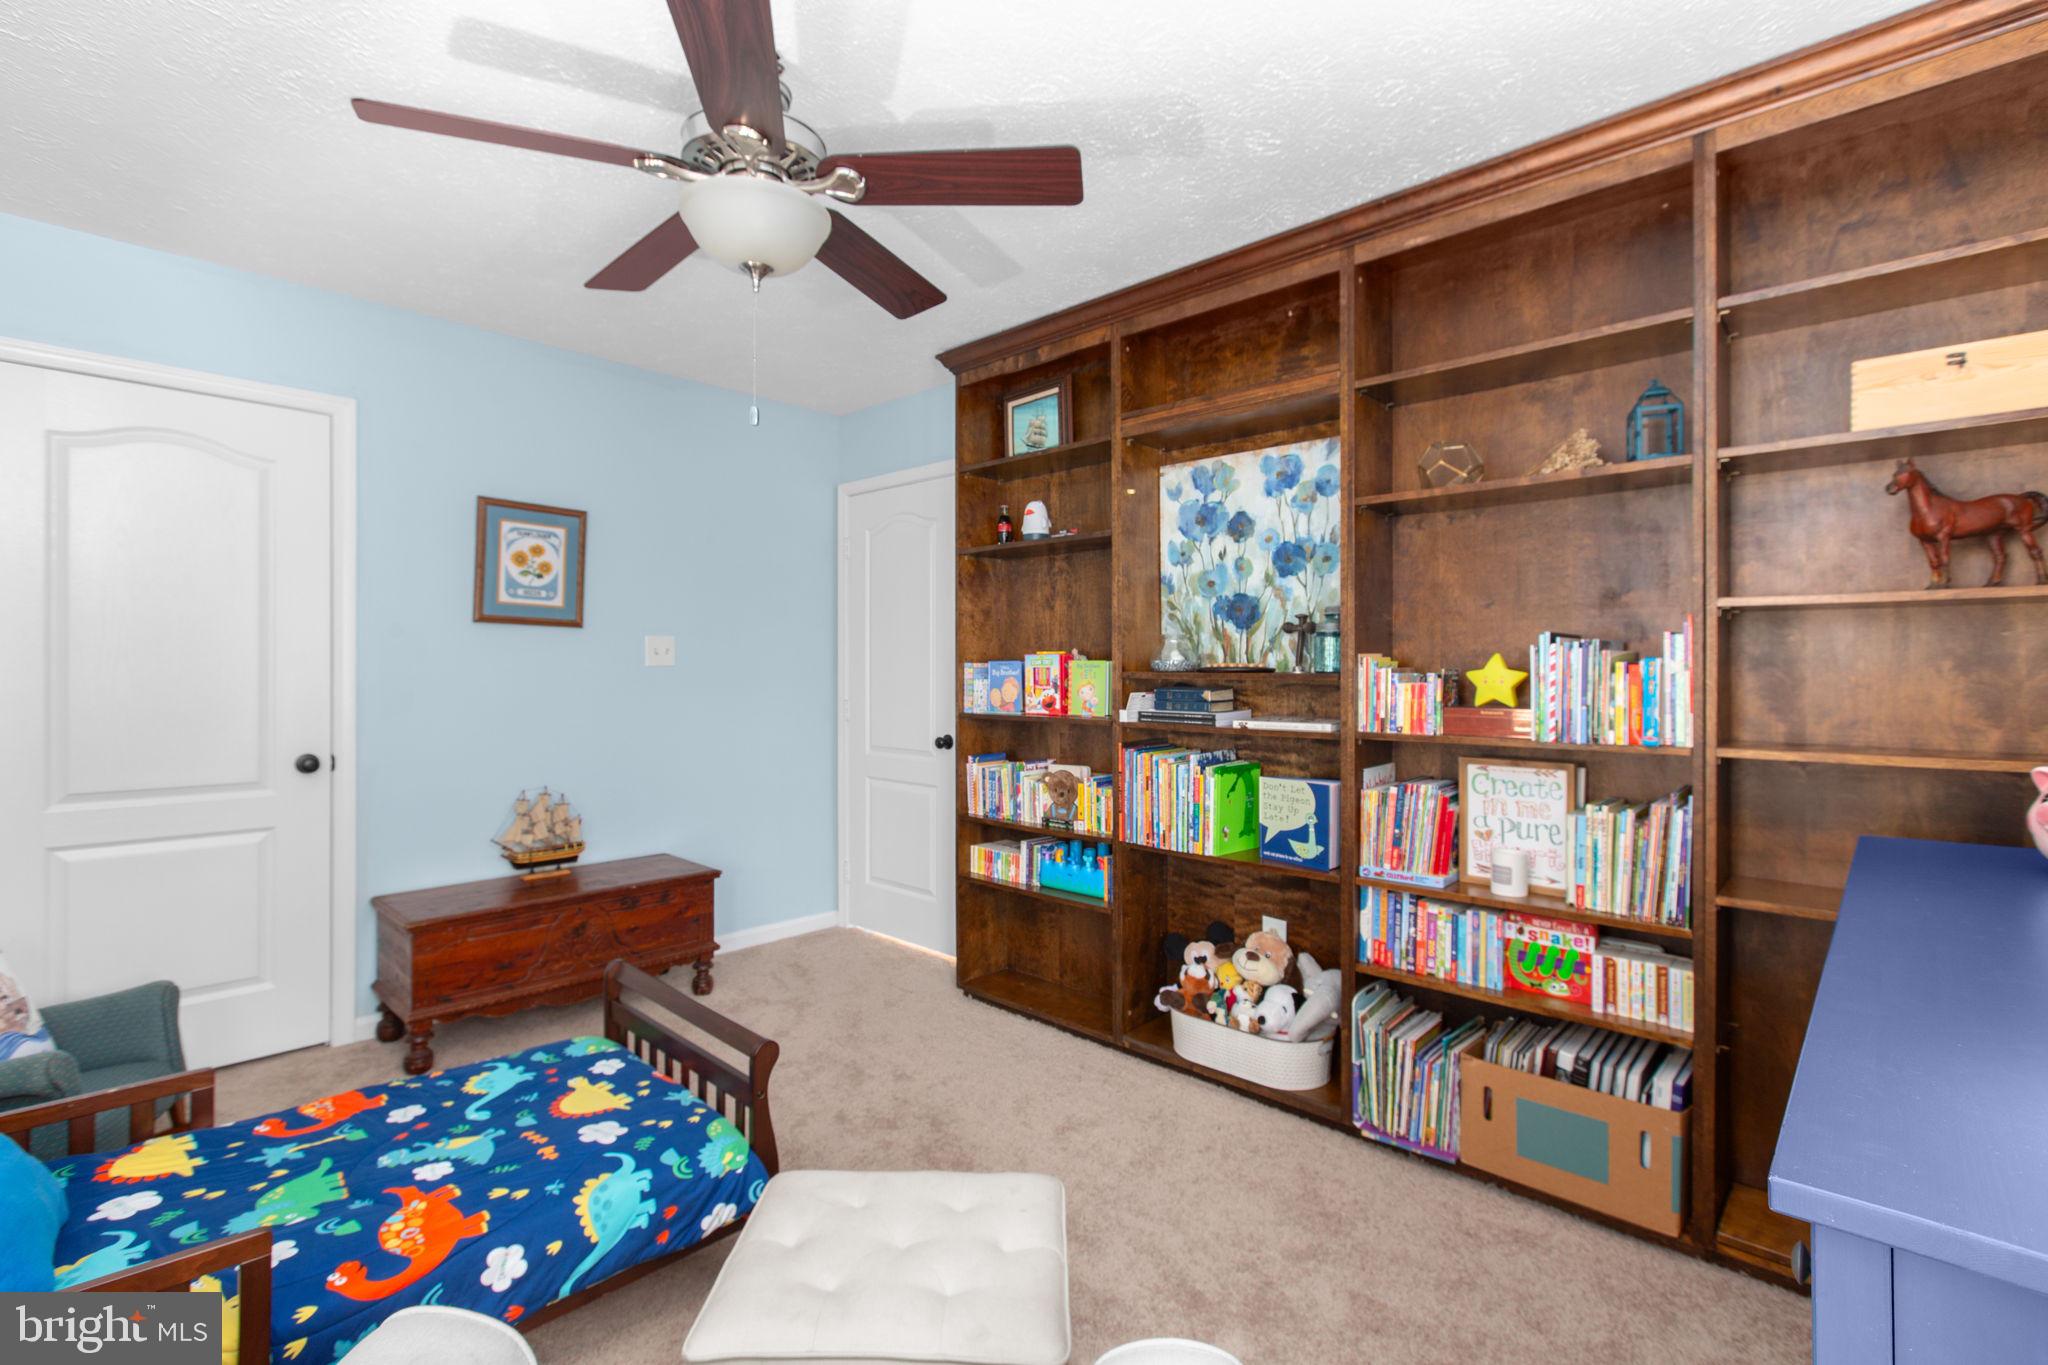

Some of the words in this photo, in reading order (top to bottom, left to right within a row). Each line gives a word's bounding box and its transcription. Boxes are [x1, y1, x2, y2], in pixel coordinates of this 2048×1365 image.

[1263, 782, 1286, 792] Don't
[1290, 785, 1305, 795] Let
[1471, 772, 1564, 801] Create
[1263, 792, 1277, 800] the
[1281, 793, 1311, 806] Pigeon
[1263, 802, 1284, 813] Stay
[1287, 805, 1300, 817] Up
[1483, 798, 1508, 817] in
[1515, 800, 1552, 820] me
[1473, 815, 1490, 829] a
[1498, 816, 1563, 846] pure
[1528, 929, 1591, 951] snake!
